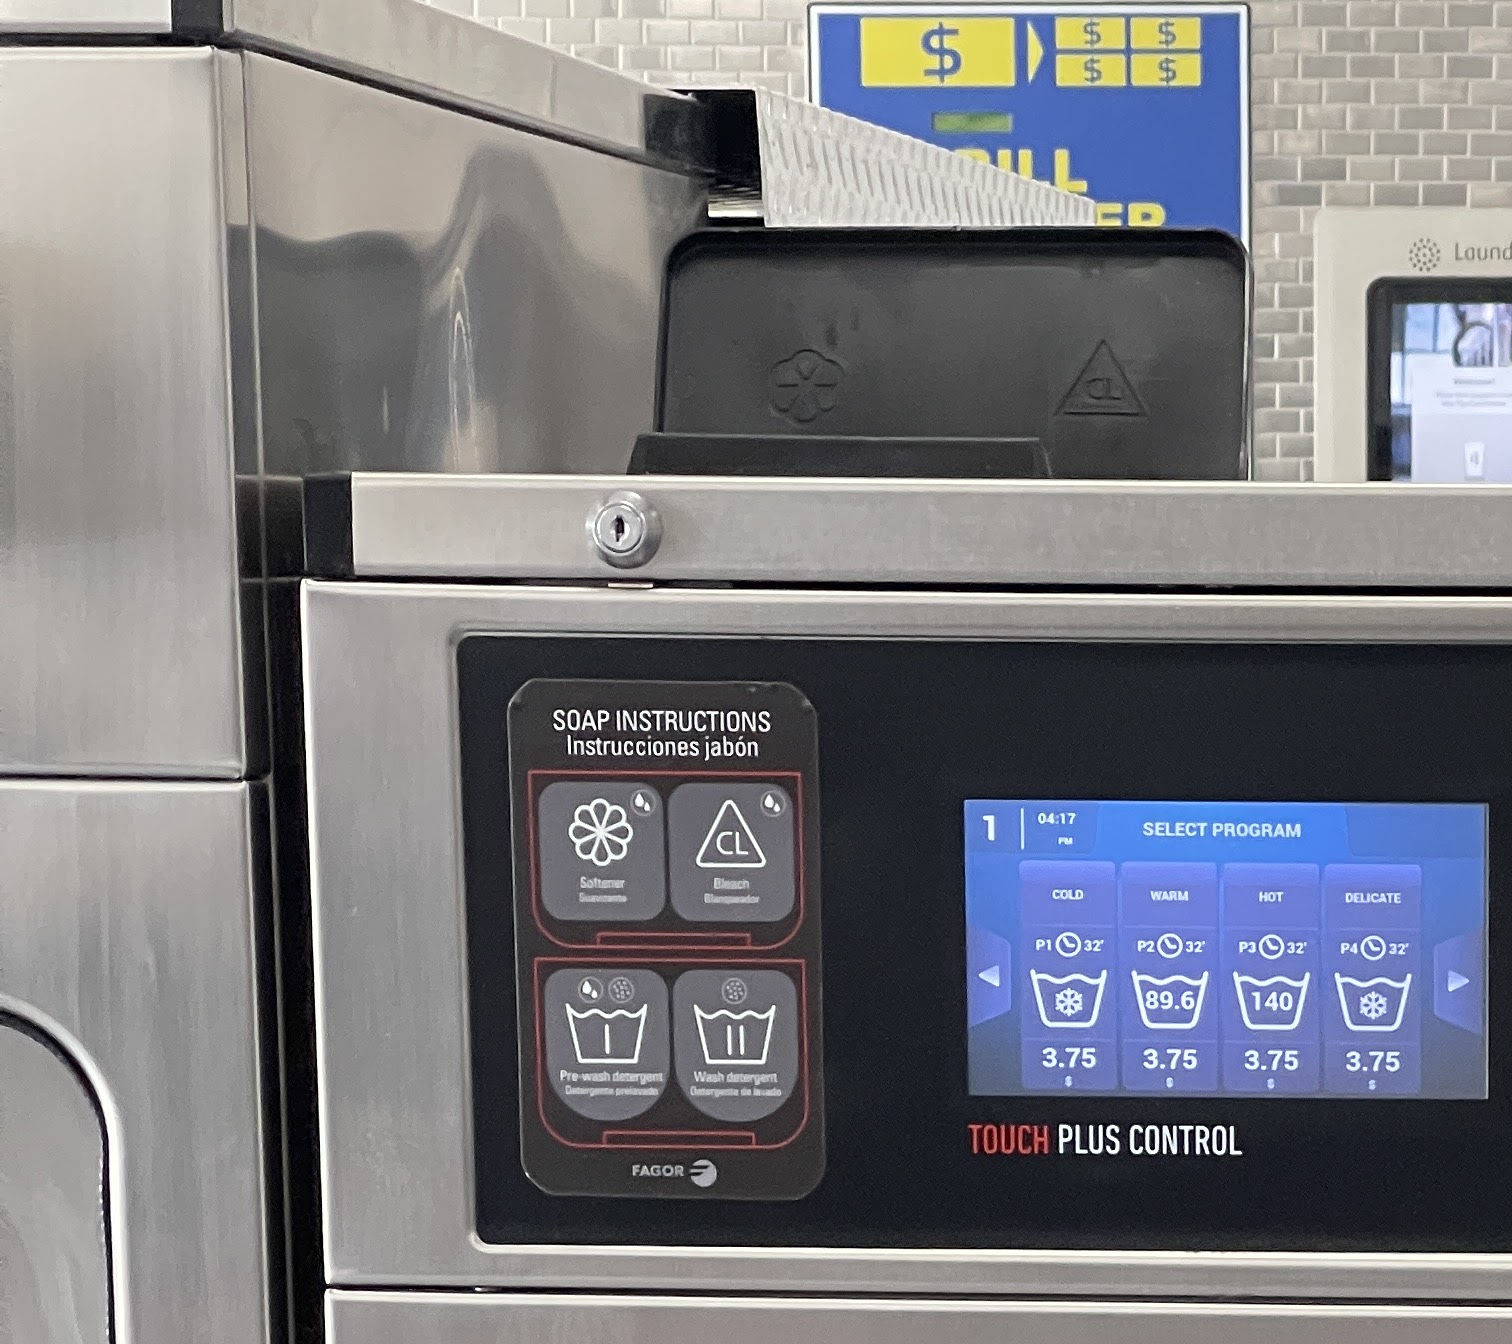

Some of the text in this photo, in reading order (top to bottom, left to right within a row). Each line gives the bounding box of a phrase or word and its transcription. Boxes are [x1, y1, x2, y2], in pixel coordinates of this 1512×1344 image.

[553, 709, 771, 732] SOAP INSTRUCTIONS
[567, 735, 759, 761] Instrucciones jabón
[1037, 812, 1077, 825] 04:17
[982, 815, 996, 841] 1
[1143, 822, 1302, 838] SELECT PROGRAM
[1058, 837, 1073, 845] PM
[1052, 889, 1084, 900] COLD
[1150, 890, 1189, 902] WARM
[1258, 891, 1284, 902] HOT
[1345, 892, 1402, 904] DELICATE
[1035, 939, 1105, 952] P1 32'
[1137, 940, 1206, 953] P2 32'
[1238, 941, 1308, 955] P3 32'
[1340, 942, 1409, 955] P4 32'
[1145, 990, 1195, 1010] 89.6
[1251, 991, 1293, 1011] 140
[1042, 1047, 1096, 1069] 3.75
[1143, 1048, 1198, 1070] 3.75
[1244, 1049, 1299, 1071] 3.75
[1345, 1051, 1401, 1073] 3.75
[694, 1071, 724, 1083] Wash
[968, 1124, 1242, 1156] TOUCH PLUS CONTROL
[632, 1164, 685, 1177] FAGOR
